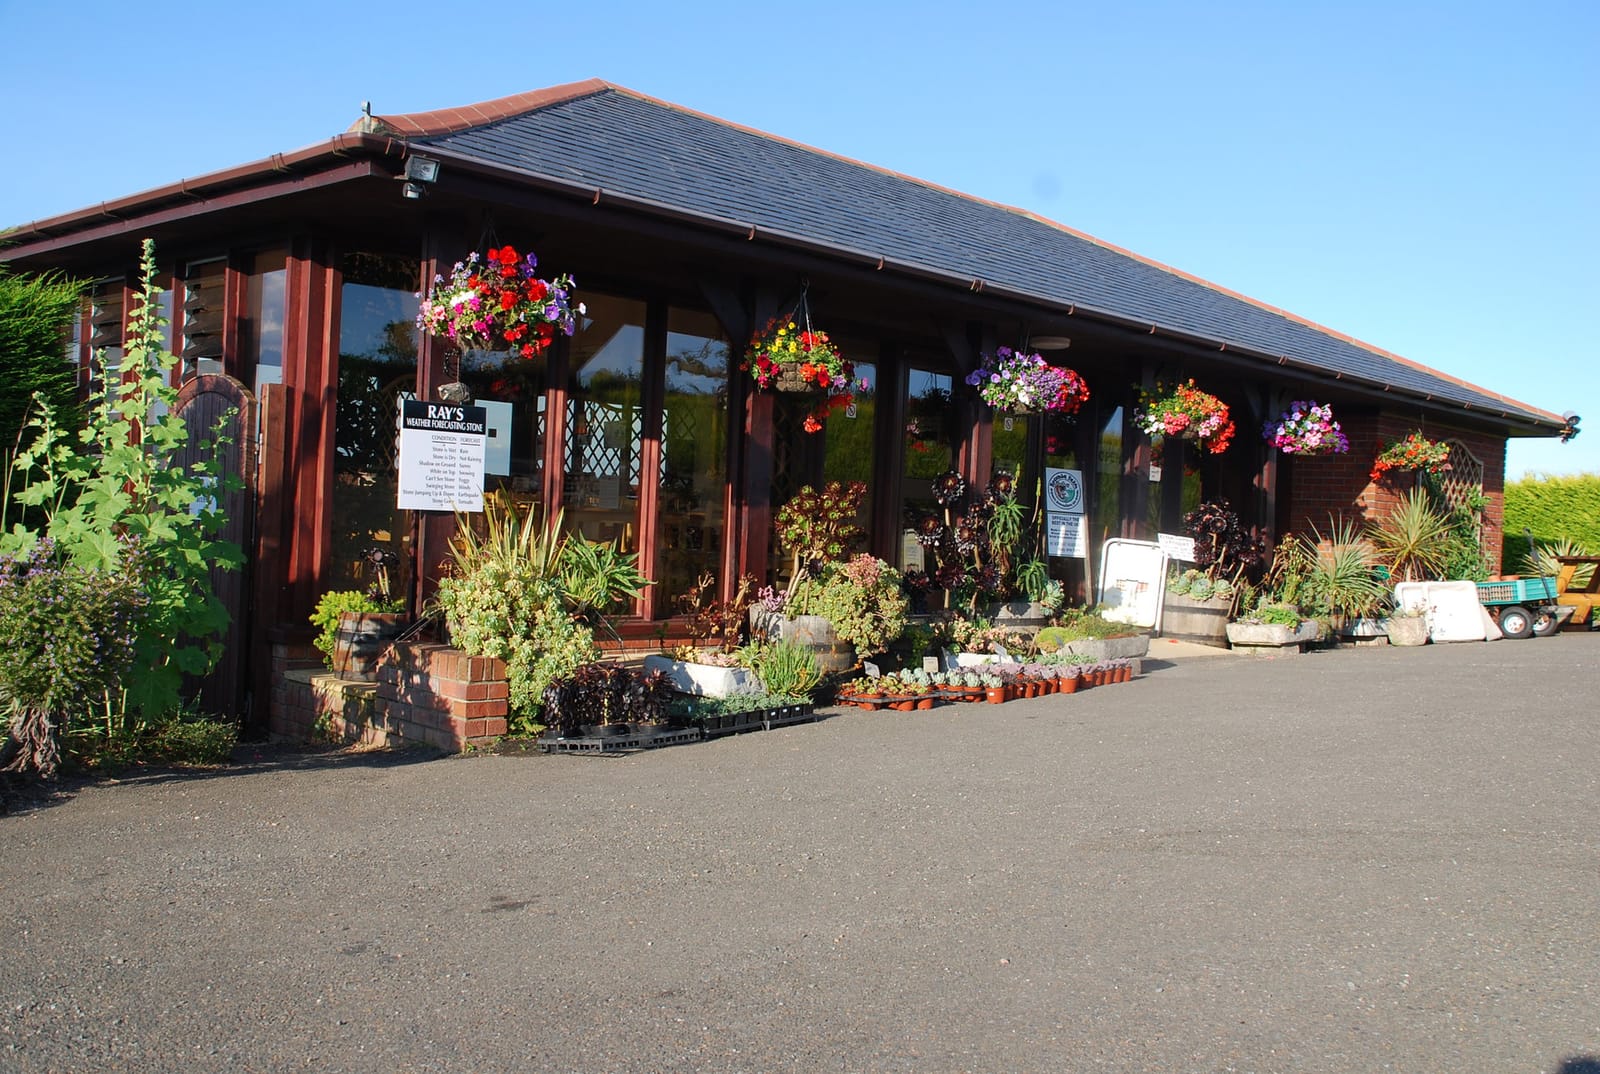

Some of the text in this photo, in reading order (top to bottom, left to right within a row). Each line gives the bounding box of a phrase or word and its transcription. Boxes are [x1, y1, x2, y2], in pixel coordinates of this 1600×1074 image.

[428, 405, 464, 421] RAY'S
[406, 418, 483, 432] WEATHER FORECASTING STONE
